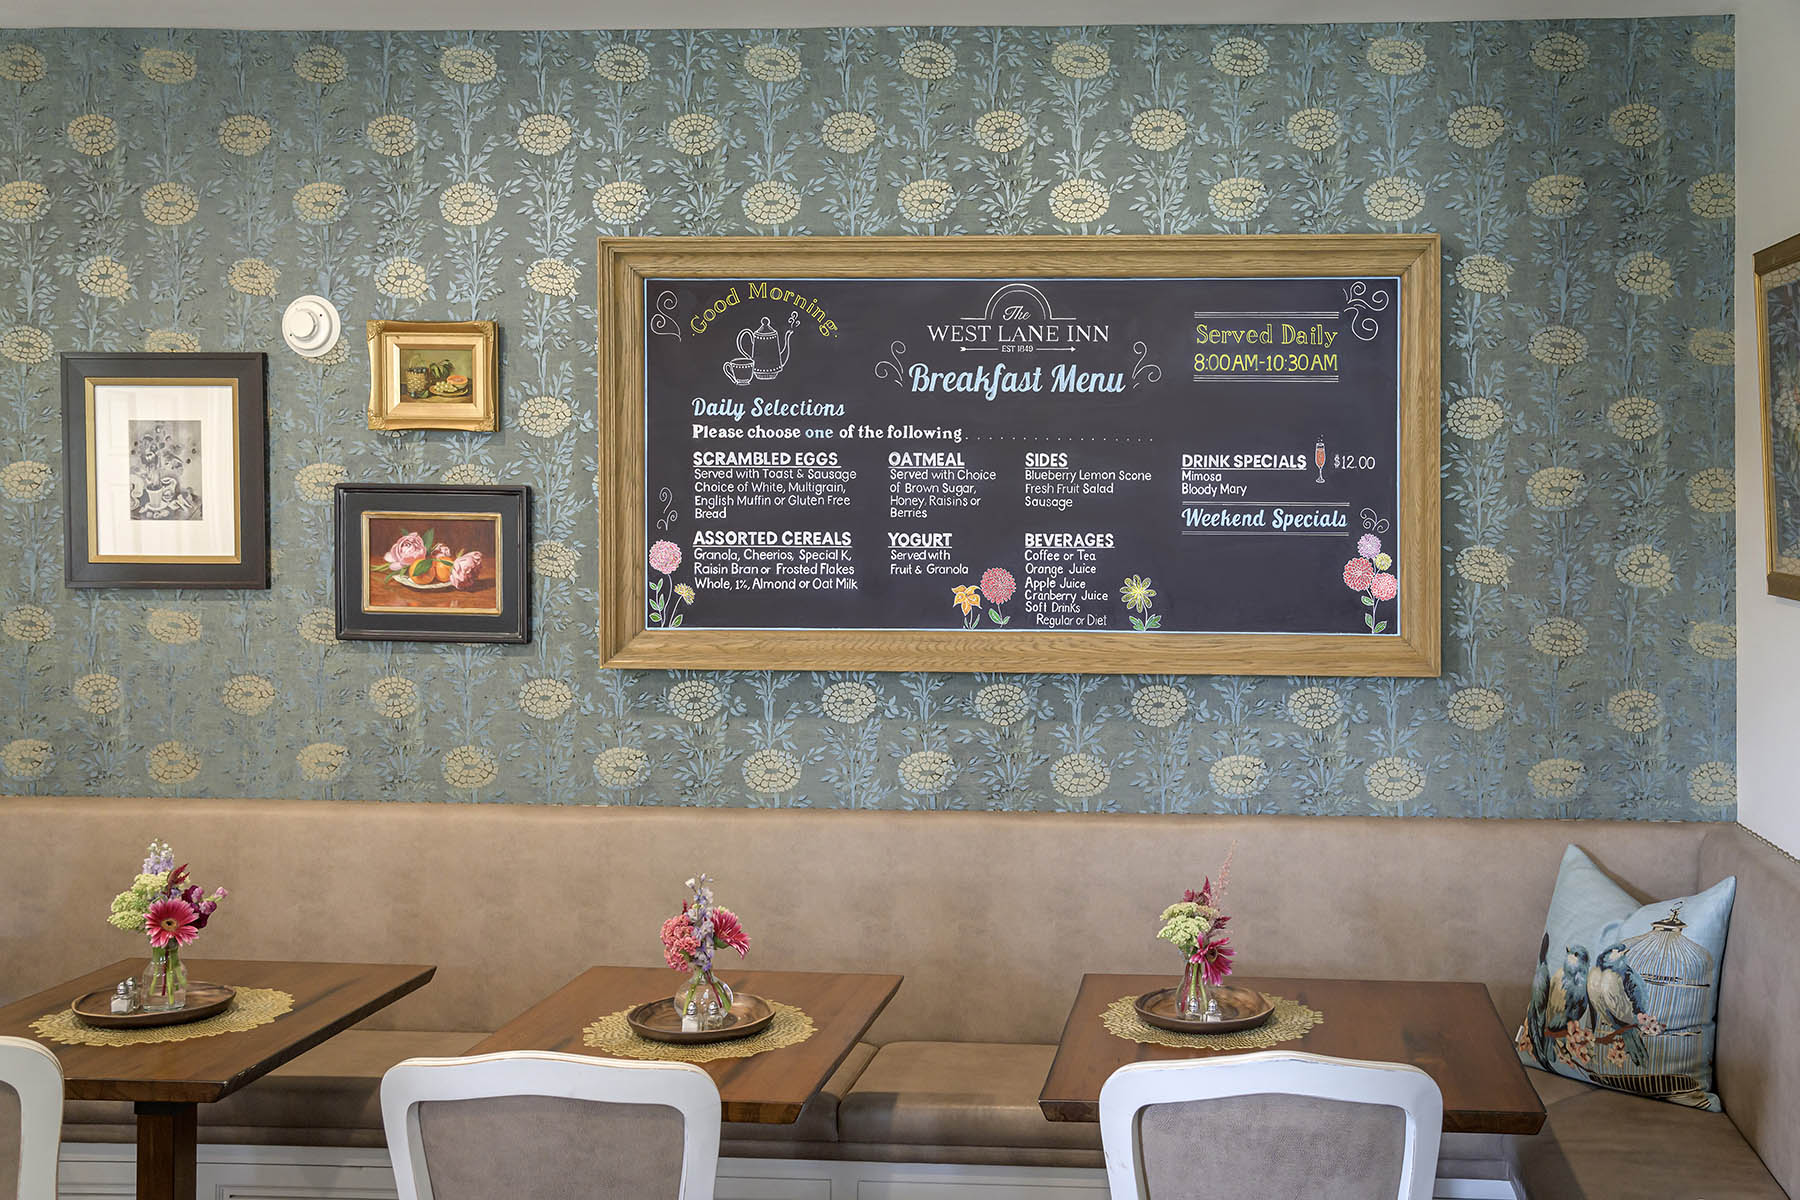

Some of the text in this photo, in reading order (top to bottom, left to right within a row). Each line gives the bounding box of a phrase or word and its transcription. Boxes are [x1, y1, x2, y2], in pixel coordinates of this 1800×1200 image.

[690, 282, 838, 337] Good Morning
[1002, 305, 1031, 321] The
[928, 325, 1110, 343] WEST LANE INN
[1196, 323, 1338, 348] Served Daily
[908, 363, 1126, 401] Breakfast Menu
[691, 397, 845, 422] Daily Selections
[692, 424, 746, 439] Please
[747, 424, 801, 439] choose
[805, 428, 833, 439] one
[839, 424, 855, 439] of
[857, 425, 884, 439] the
[693, 451, 838, 466] SCRAMBLED EGGS
[888, 452, 965, 466] OATMEAL
[1025, 453, 1068, 467] SIDES
[1182, 454, 1307, 469] DRINK SPECIALS
[1333, 454, 1376, 470] $12.00
[694, 468, 857, 482] Served with Toast & Sausage
[890, 469, 996, 480] Served with Choice
[1025, 470, 1151, 483] Blueberry Lemon Scone
[1182, 470, 1222, 482] Mimosa
[694, 482, 734, 493] Choice
[737, 482, 748, 493] of
[890, 482, 901, 493] of
[905, 483, 939, 494] Brown
[1025, 483, 1113, 494] Fresh Fruit Salad
[1182, 483, 1247, 497] Bloody Mary
[695, 495, 851, 509] English Muffin or Gluten Free
[929, 495, 968, 506] Raisins
[970, 497, 981, 506] or
[1025, 496, 1073, 511] Sausage
[695, 507, 727, 519] Bread
[890, 508, 927, 518] Berries
[1181, 507, 1348, 531] Weekend Specials
[693, 531, 852, 546] ASSORTED CEREALS
[888, 532, 952, 547] YOGURT
[1025, 533, 1114, 547] BEVERAGES
[799, 550, 838, 562] Special
[890, 550, 950, 560] Served with
[1024, 549, 1096, 561] Coffee or Tea
[694, 563, 855, 575] Raisin Bran or Frosted Flakes
[890, 564, 969, 575] Fruit & Granola
[1025, 563, 1096, 578] Orange Juice
[752, 578, 796, 590] Almond
[799, 580, 810, 590] or
[812, 578, 833, 590] Oat
[835, 578, 858, 590] Milk
[1025, 577, 1086, 591] Apple Juice
[1024, 589, 1108, 604] Cranberry Juice
[1025, 601, 1047, 612] Soft
[1036, 614, 1107, 628] Regular or Diet
